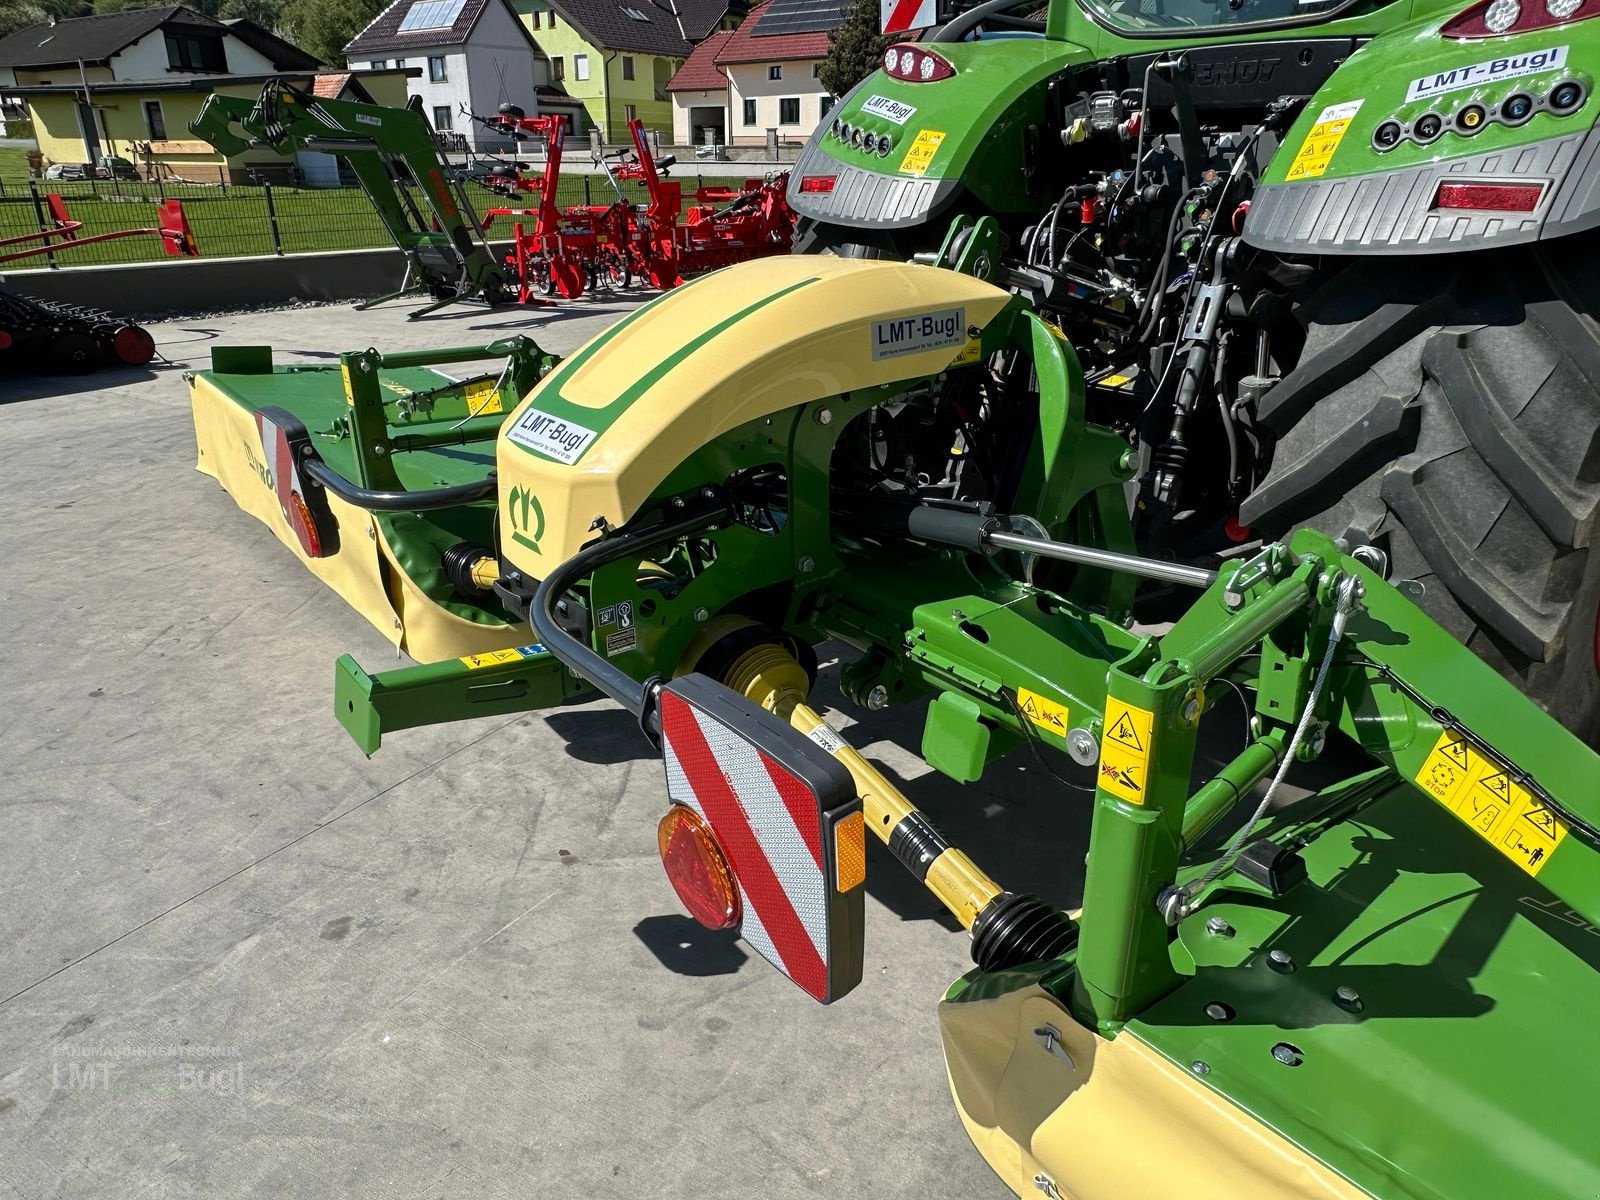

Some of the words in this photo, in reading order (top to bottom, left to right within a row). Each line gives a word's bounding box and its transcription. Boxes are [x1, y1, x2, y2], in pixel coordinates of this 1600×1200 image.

[1416, 48, 1558, 93] LMT-Bugl
[866, 96, 913, 119] LMT-Bugl
[878, 311, 960, 345] LMT-Bugl
[520, 411, 590, 452] LMT-Bugl
[1425, 779, 1446, 796] STOP
